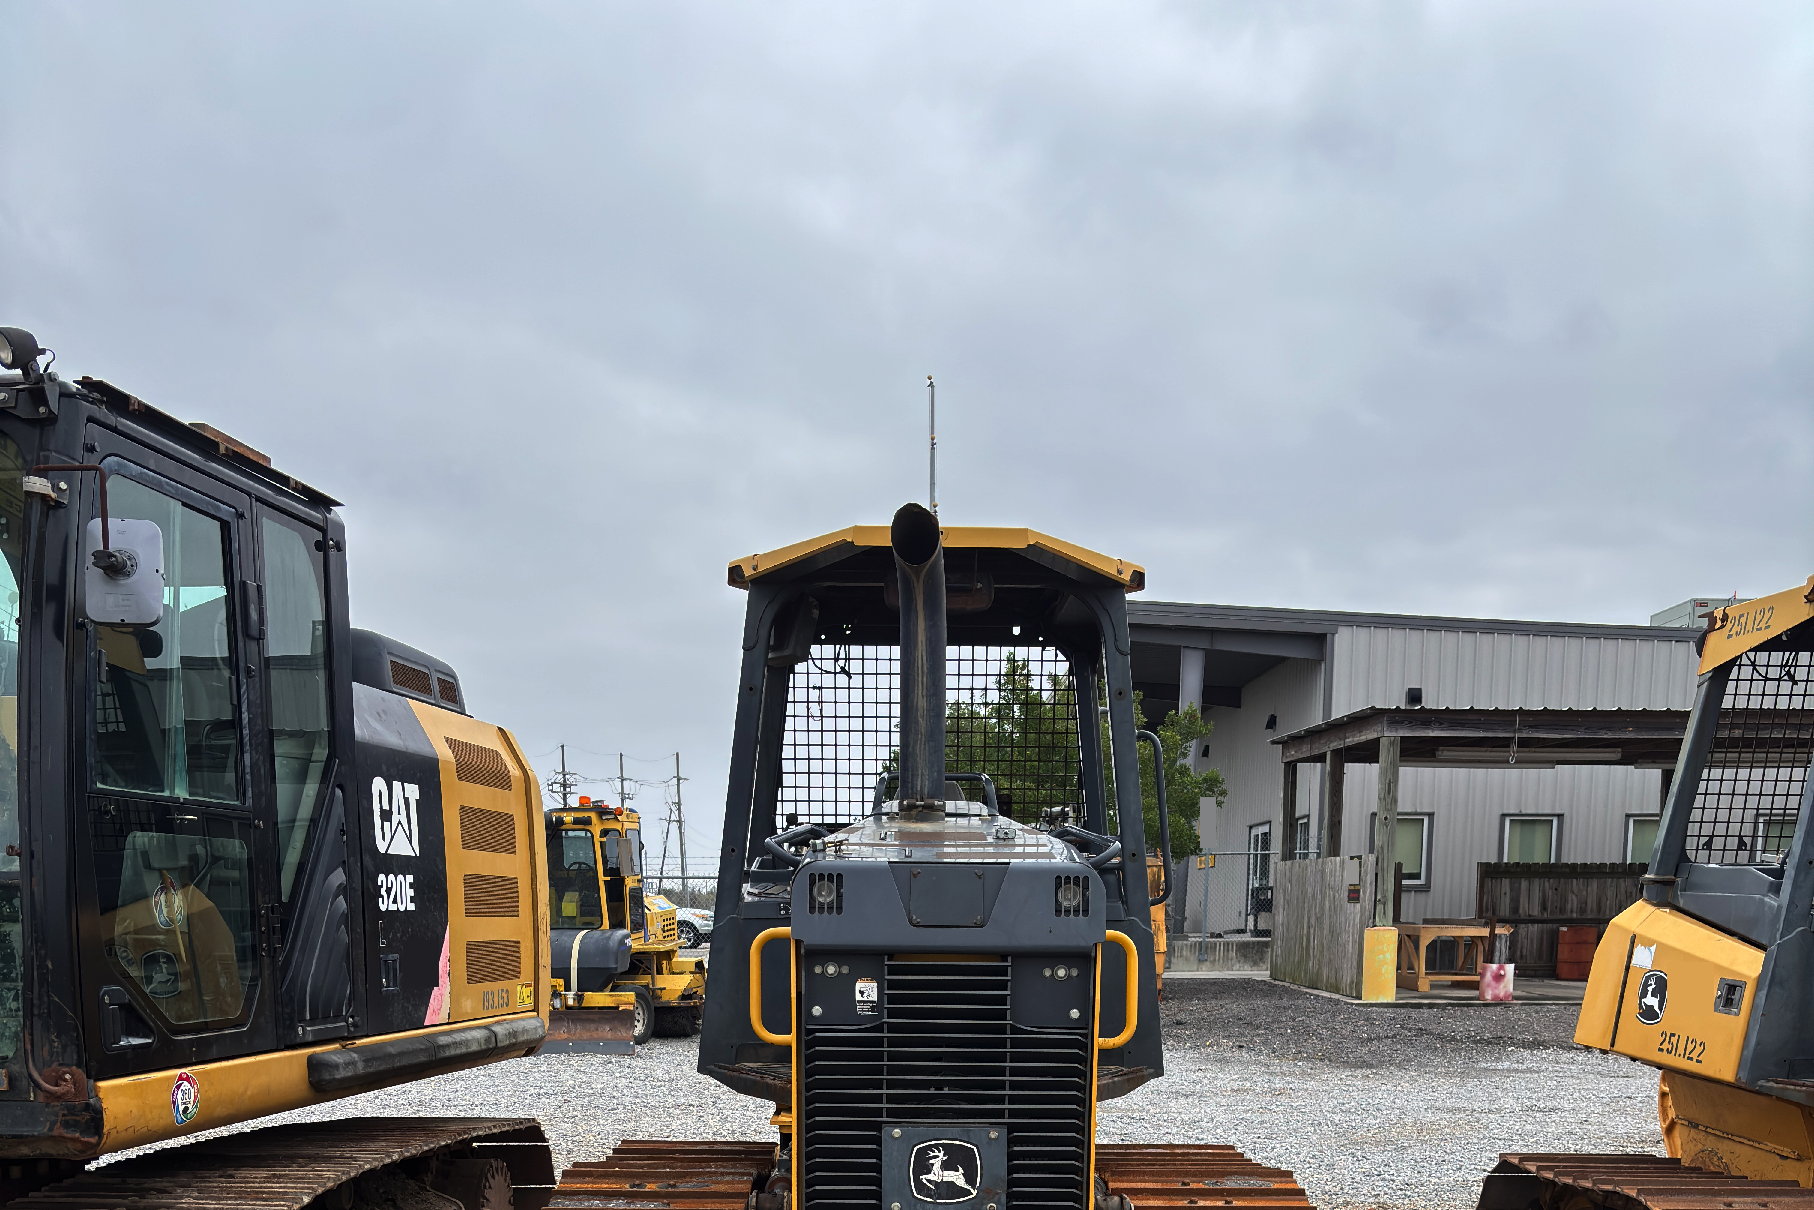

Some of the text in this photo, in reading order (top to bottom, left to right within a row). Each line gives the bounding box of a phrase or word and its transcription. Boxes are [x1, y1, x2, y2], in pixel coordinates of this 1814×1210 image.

[1727, 605, 1774, 640] 251.122
[372, 776, 420, 857] CAT
[377, 873, 416, 912] 320E
[482, 988, 510, 1011] 193.153
[1657, 1030, 1706, 1064] 251.122
